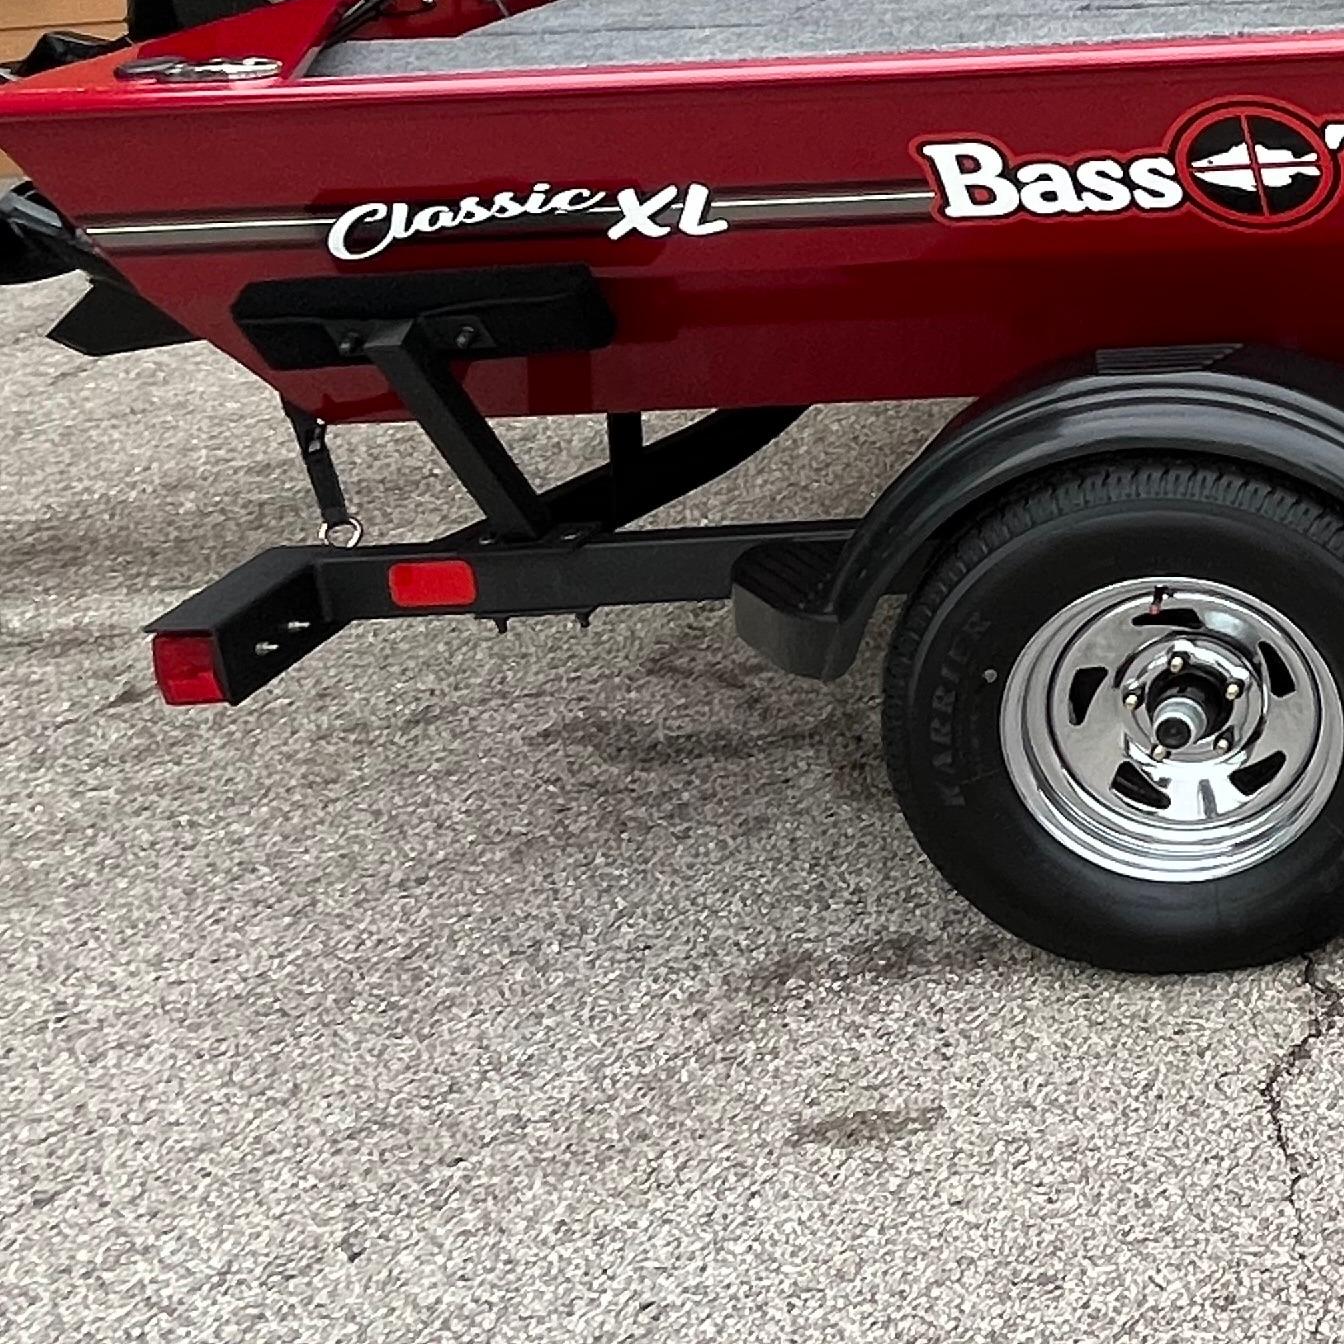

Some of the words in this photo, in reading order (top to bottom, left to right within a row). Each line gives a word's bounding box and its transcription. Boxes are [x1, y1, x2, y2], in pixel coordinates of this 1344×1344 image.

[923, 141, 1178, 219] Bass
[327, 182, 606, 260] Classic
[606, 183, 730, 241] XL
